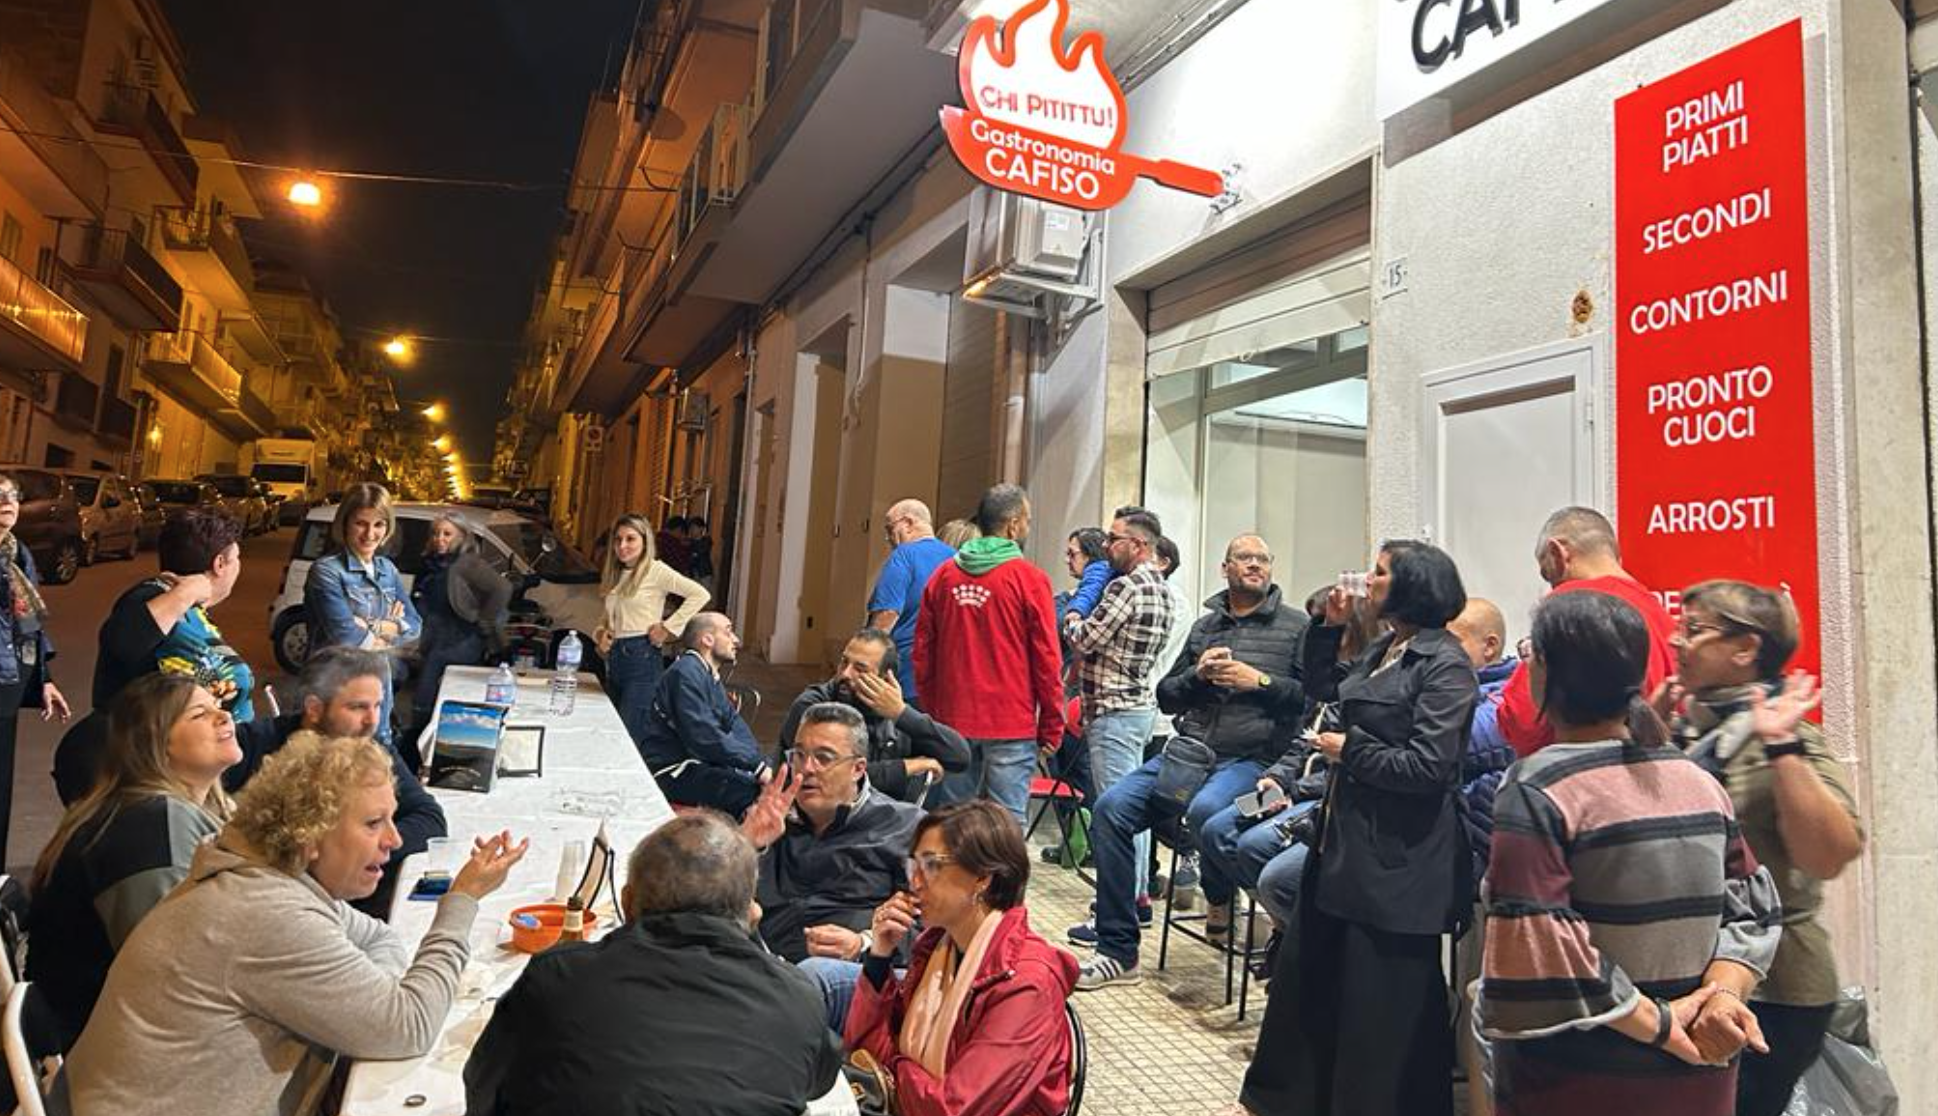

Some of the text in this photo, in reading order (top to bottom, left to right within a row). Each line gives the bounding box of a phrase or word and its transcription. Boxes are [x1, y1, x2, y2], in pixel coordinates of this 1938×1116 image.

[980, 85, 1114, 129] CHI PITITTU!
[1665, 80, 1745, 137] PRIMI
[970, 118, 1116, 176] Gastronomia
[1662, 115, 1749, 173] PIATTI
[985, 147, 1100, 200] CAFISO
[1642, 188, 1771, 254] SECONDI
[1630, 269, 1788, 334] CONTORNI
[1648, 365, 1773, 414] PRONTO
[1663, 405, 1756, 447] CUOCI
[1646, 495, 1775, 534] ARROSTI
